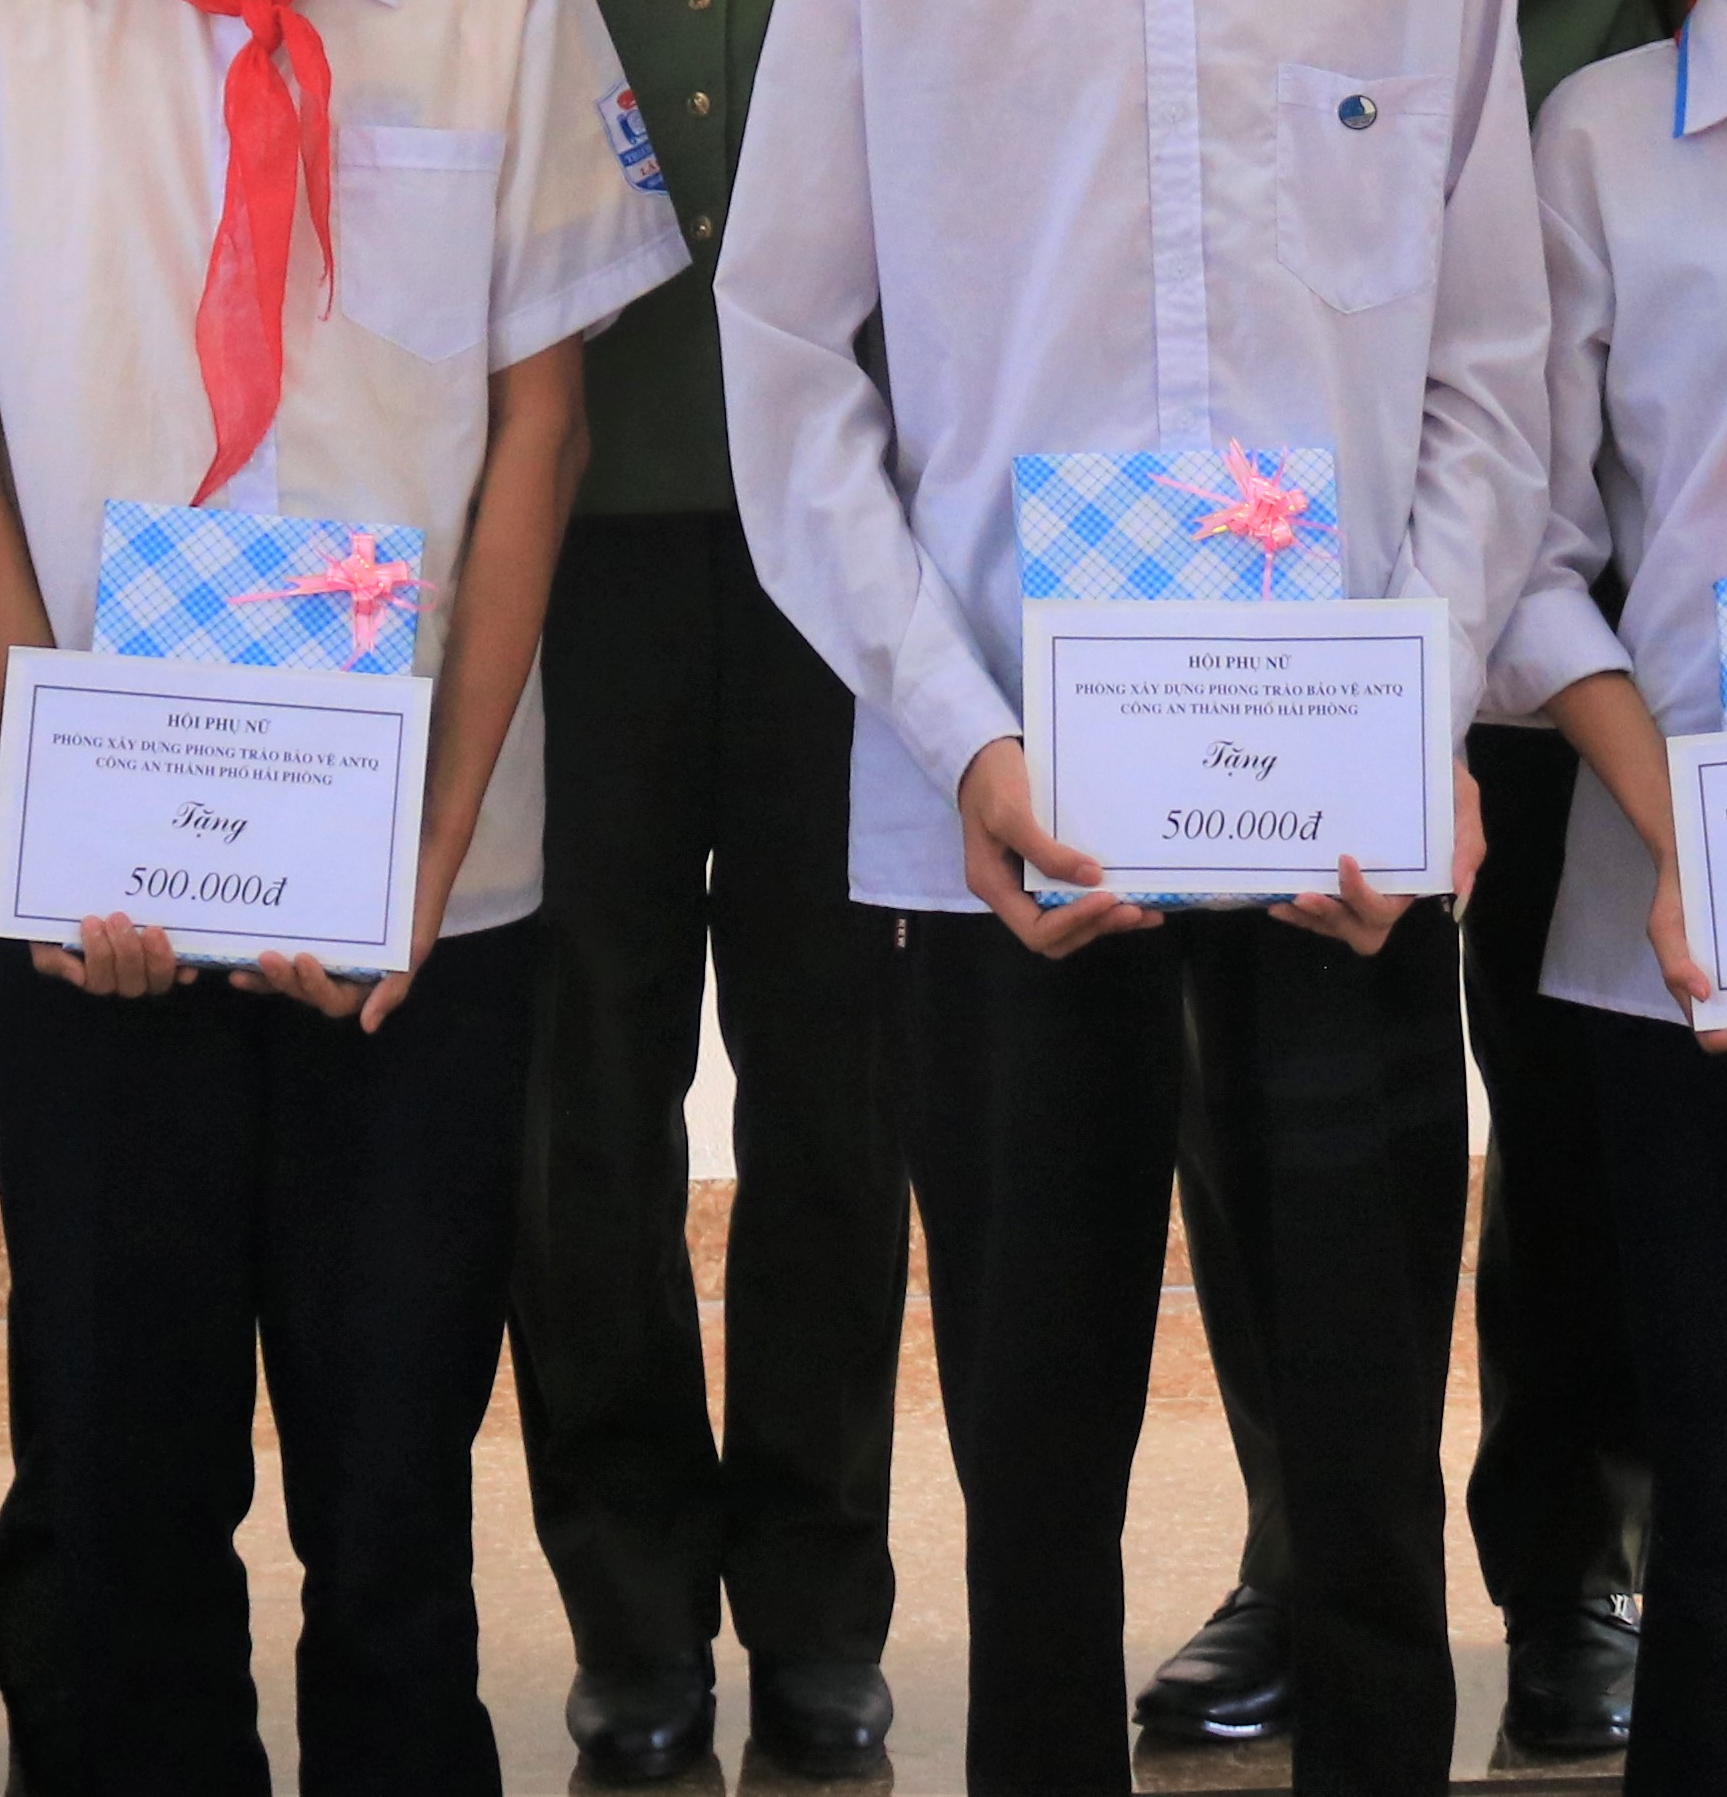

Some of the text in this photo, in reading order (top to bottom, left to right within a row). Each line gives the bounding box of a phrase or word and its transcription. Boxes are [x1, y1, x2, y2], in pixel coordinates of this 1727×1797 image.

[1188, 652, 1291, 672] HỘI PHỤ NỮ
[1075, 681, 1126, 695] PHÒNG
[1130, 681, 1159, 695] XÂY
[1208, 684, 1258, 695] PHONG
[1363, 683, 1403, 697] ANTQ
[167, 712, 271, 734] HỘI PHỤ NỮ
[1120, 700, 1162, 714] CÔNG
[1166, 703, 1186, 714] AN
[1244, 700, 1274, 715] PHỐ
[1307, 701, 1358, 715] PHÒNG
[52, 732, 103, 748] PHÒNG
[107, 735, 137, 750] XÂY
[185, 743, 235, 758] PHONG
[339, 756, 379, 771] ANTQ
[1202, 740, 1277, 781] Tặng
[95, 754, 137, 770] CÔNG
[140, 760, 161, 772] AN
[218, 764, 249, 779] PHỐ
[281, 770, 332, 785] PHÒNG
[171, 801, 248, 844] Tặng
[1162, 809, 1323, 841] 500.000đ
[124, 866, 287, 906] 500.000đ
